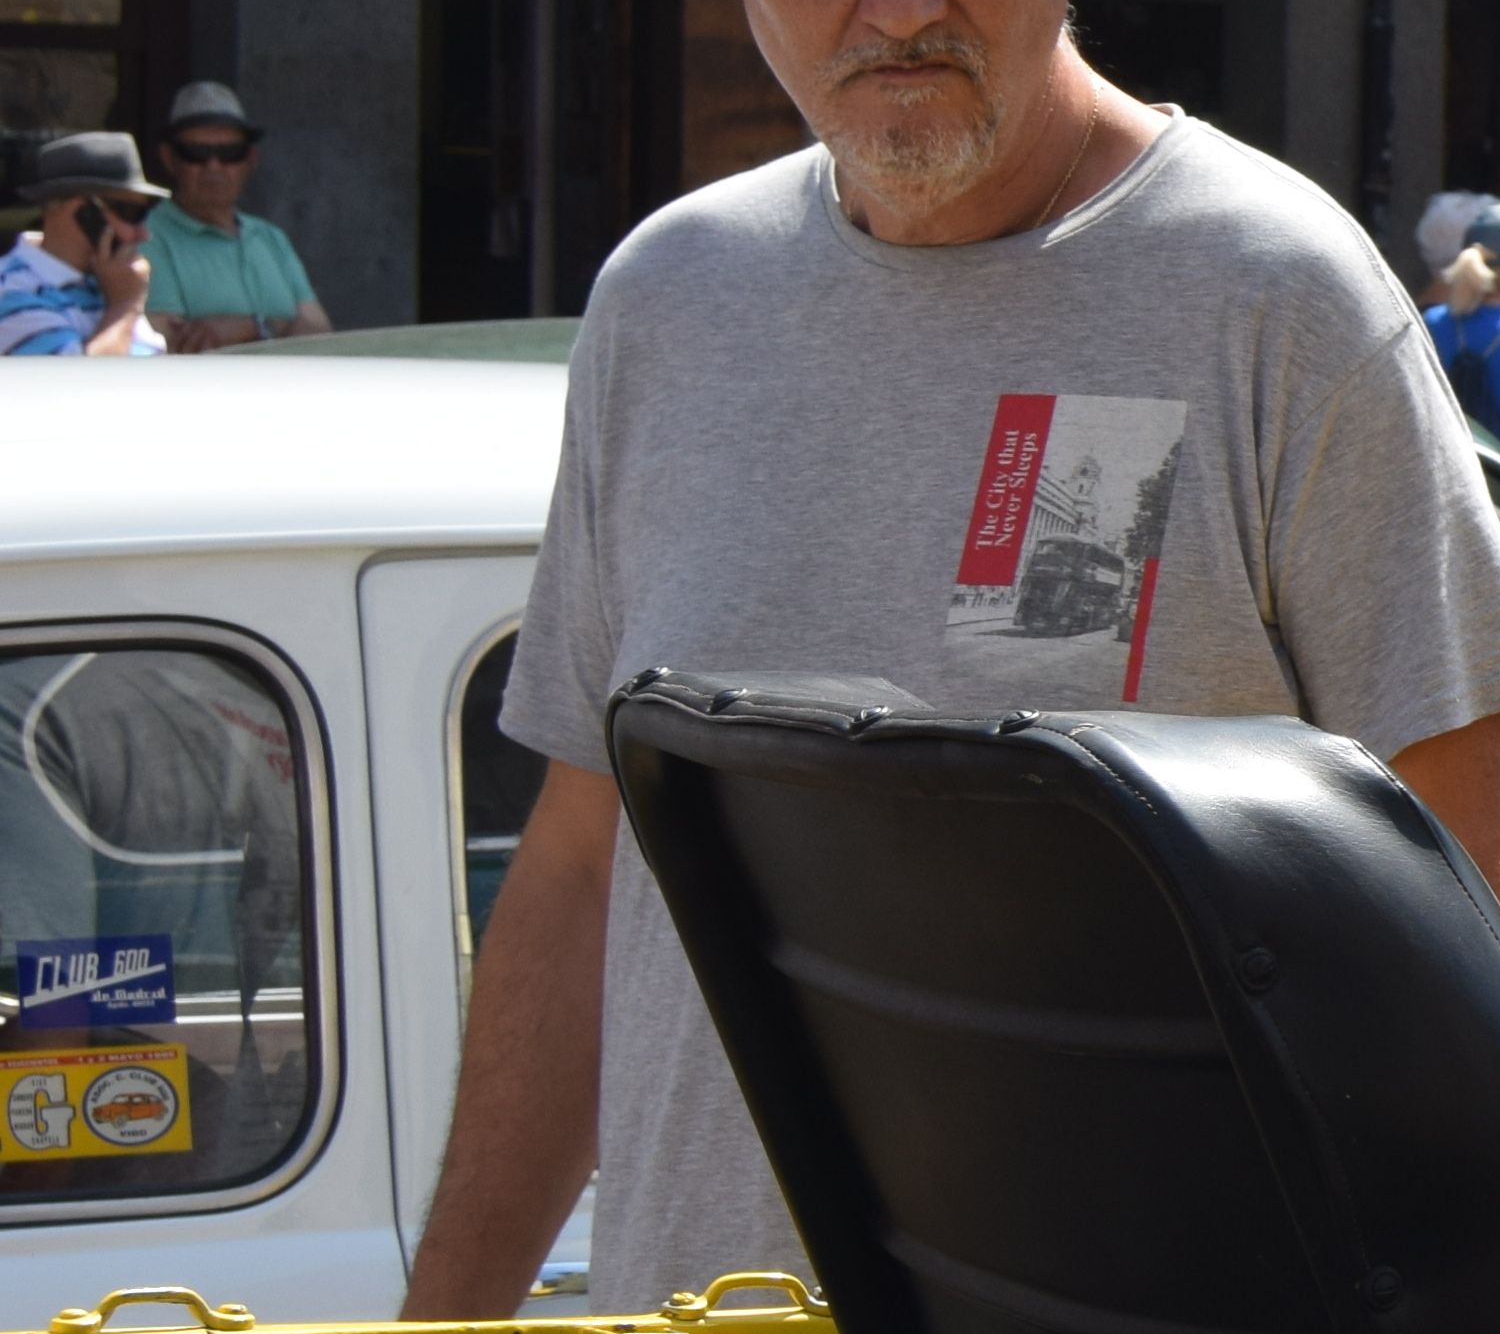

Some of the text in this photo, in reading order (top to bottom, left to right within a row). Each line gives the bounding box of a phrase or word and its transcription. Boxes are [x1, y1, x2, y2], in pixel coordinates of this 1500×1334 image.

[976, 429, 1020, 551] The City that
[994, 433, 1038, 548] Never Sleeps
[36, 948, 151, 995] CLUB 600
